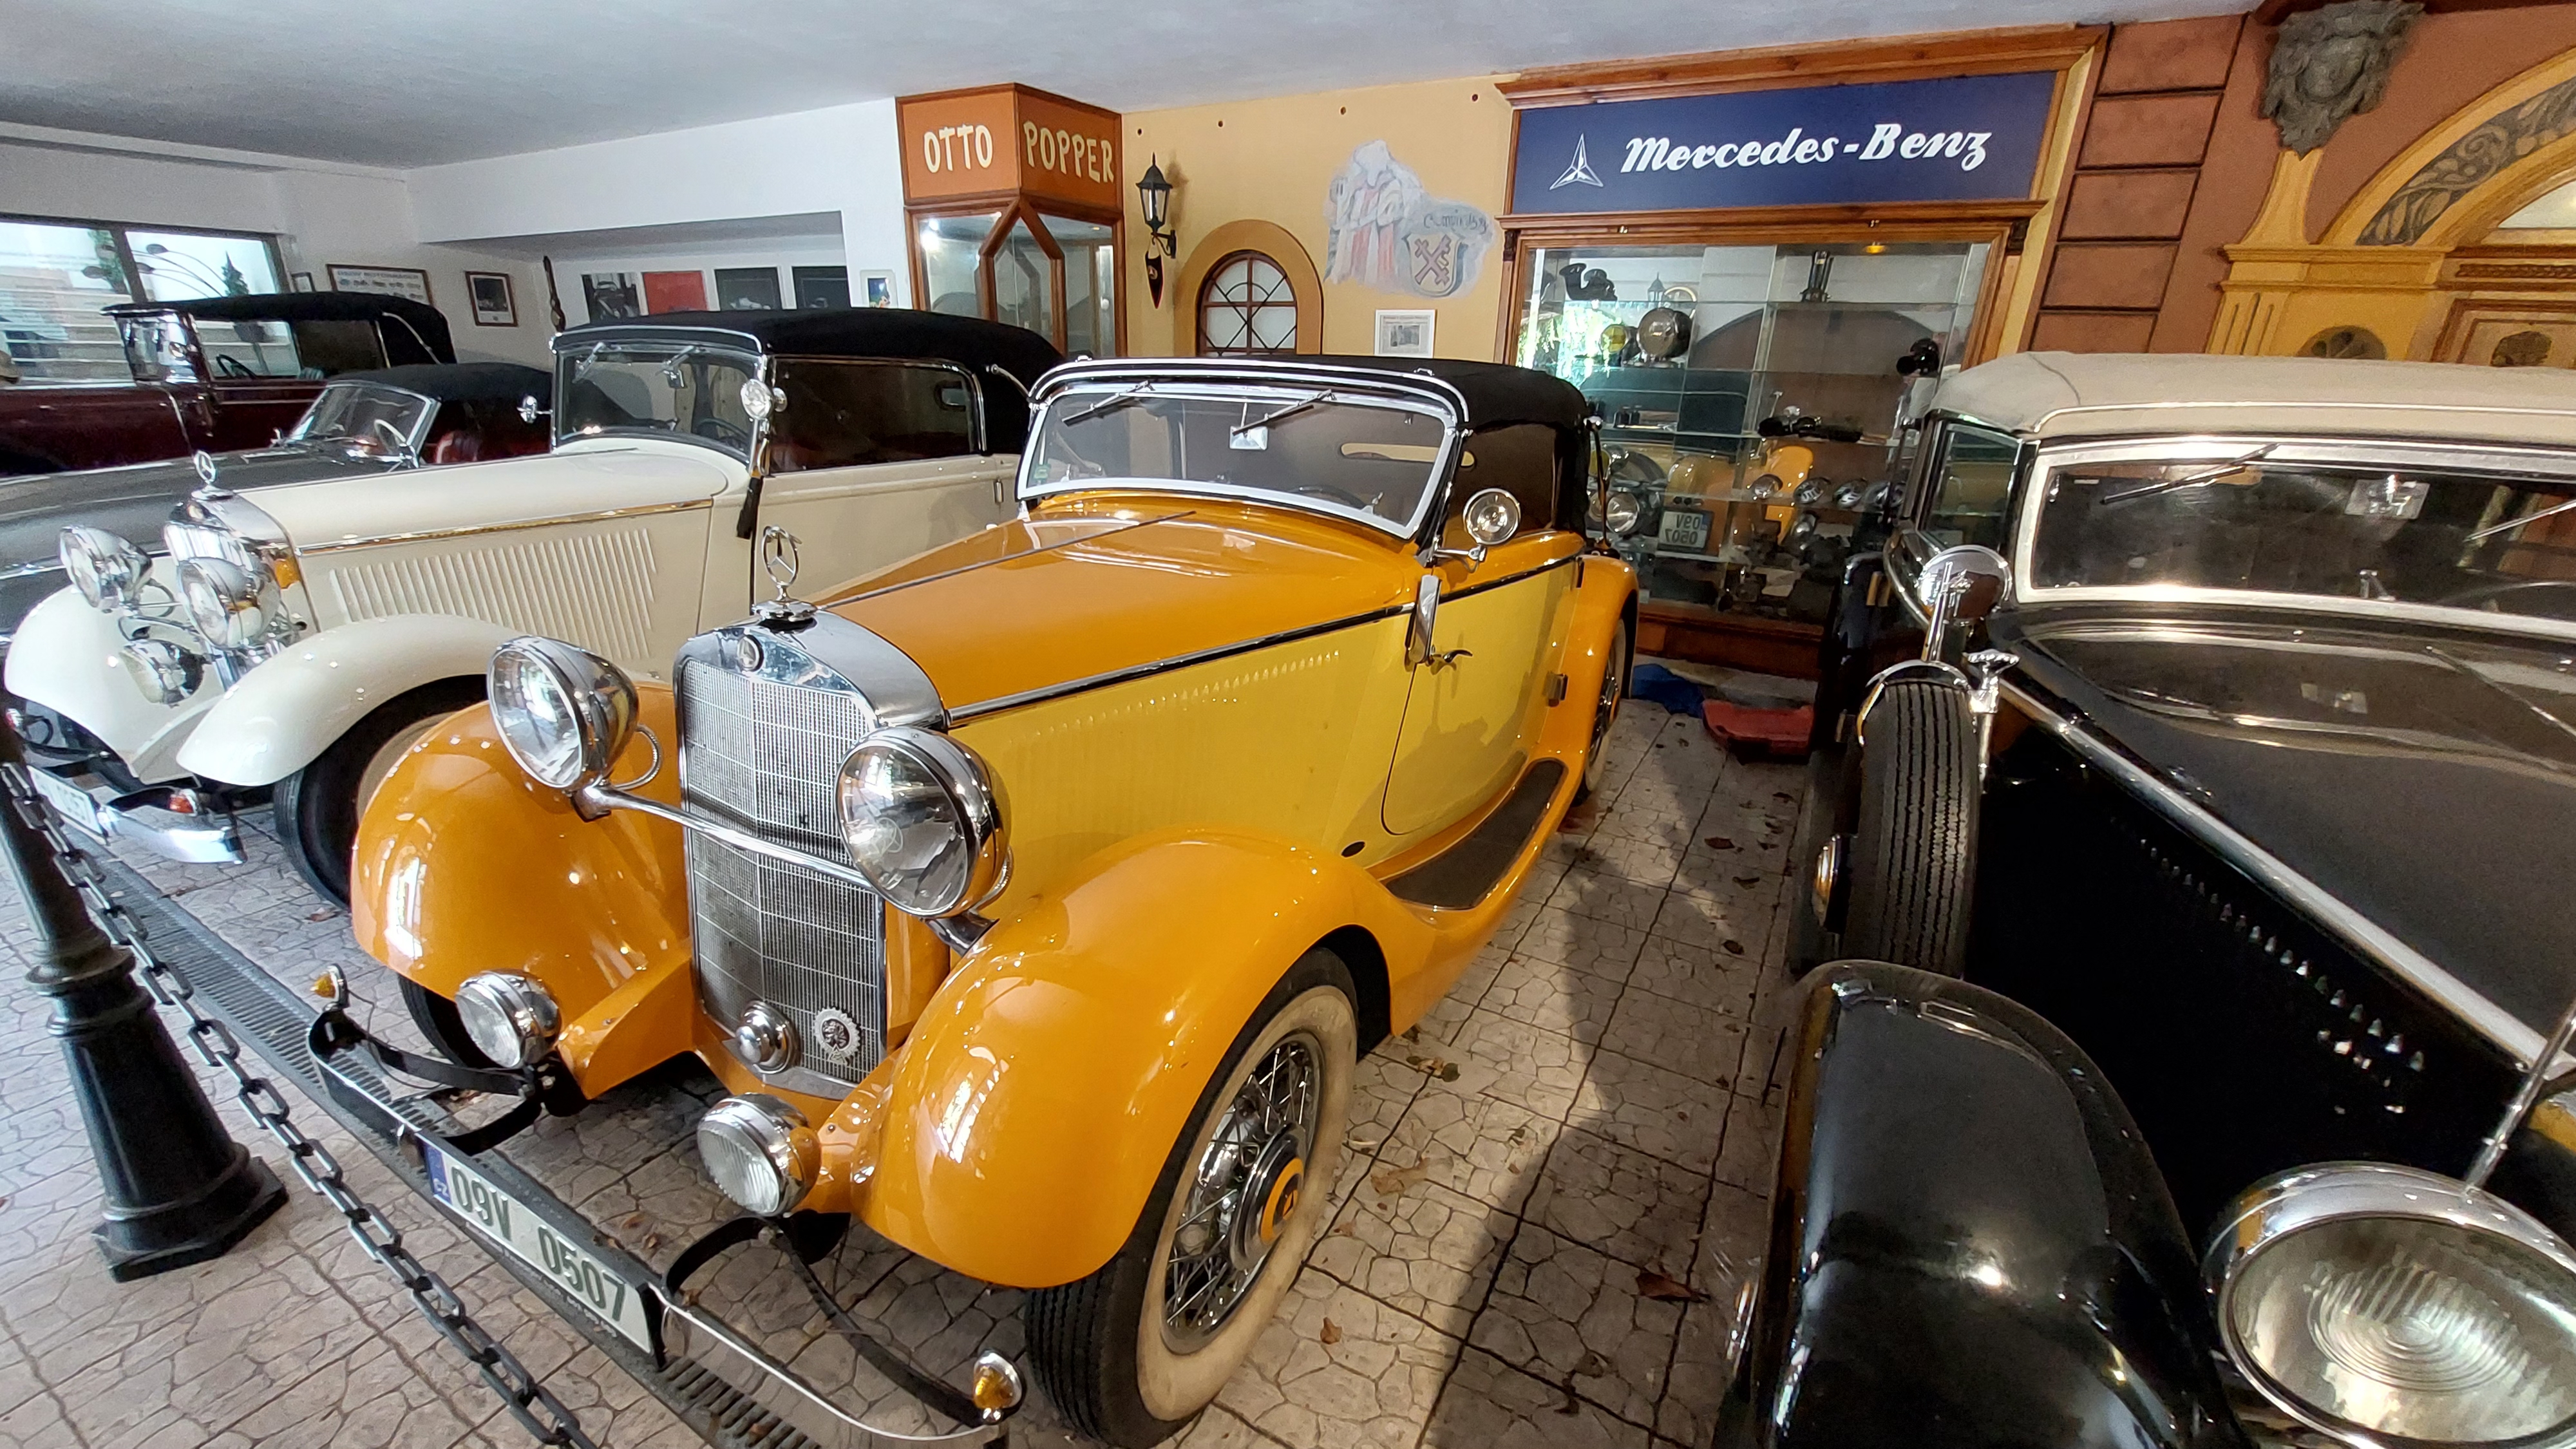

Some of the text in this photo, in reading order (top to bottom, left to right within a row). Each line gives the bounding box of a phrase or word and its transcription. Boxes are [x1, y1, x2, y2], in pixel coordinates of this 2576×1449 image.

[923, 120, 1114, 184] OTTO POPPER
[1620, 123, 1993, 172] Mercedes-Benz
[451, 1164, 512, 1241] 09V
[538, 1224, 626, 1321] 0507
